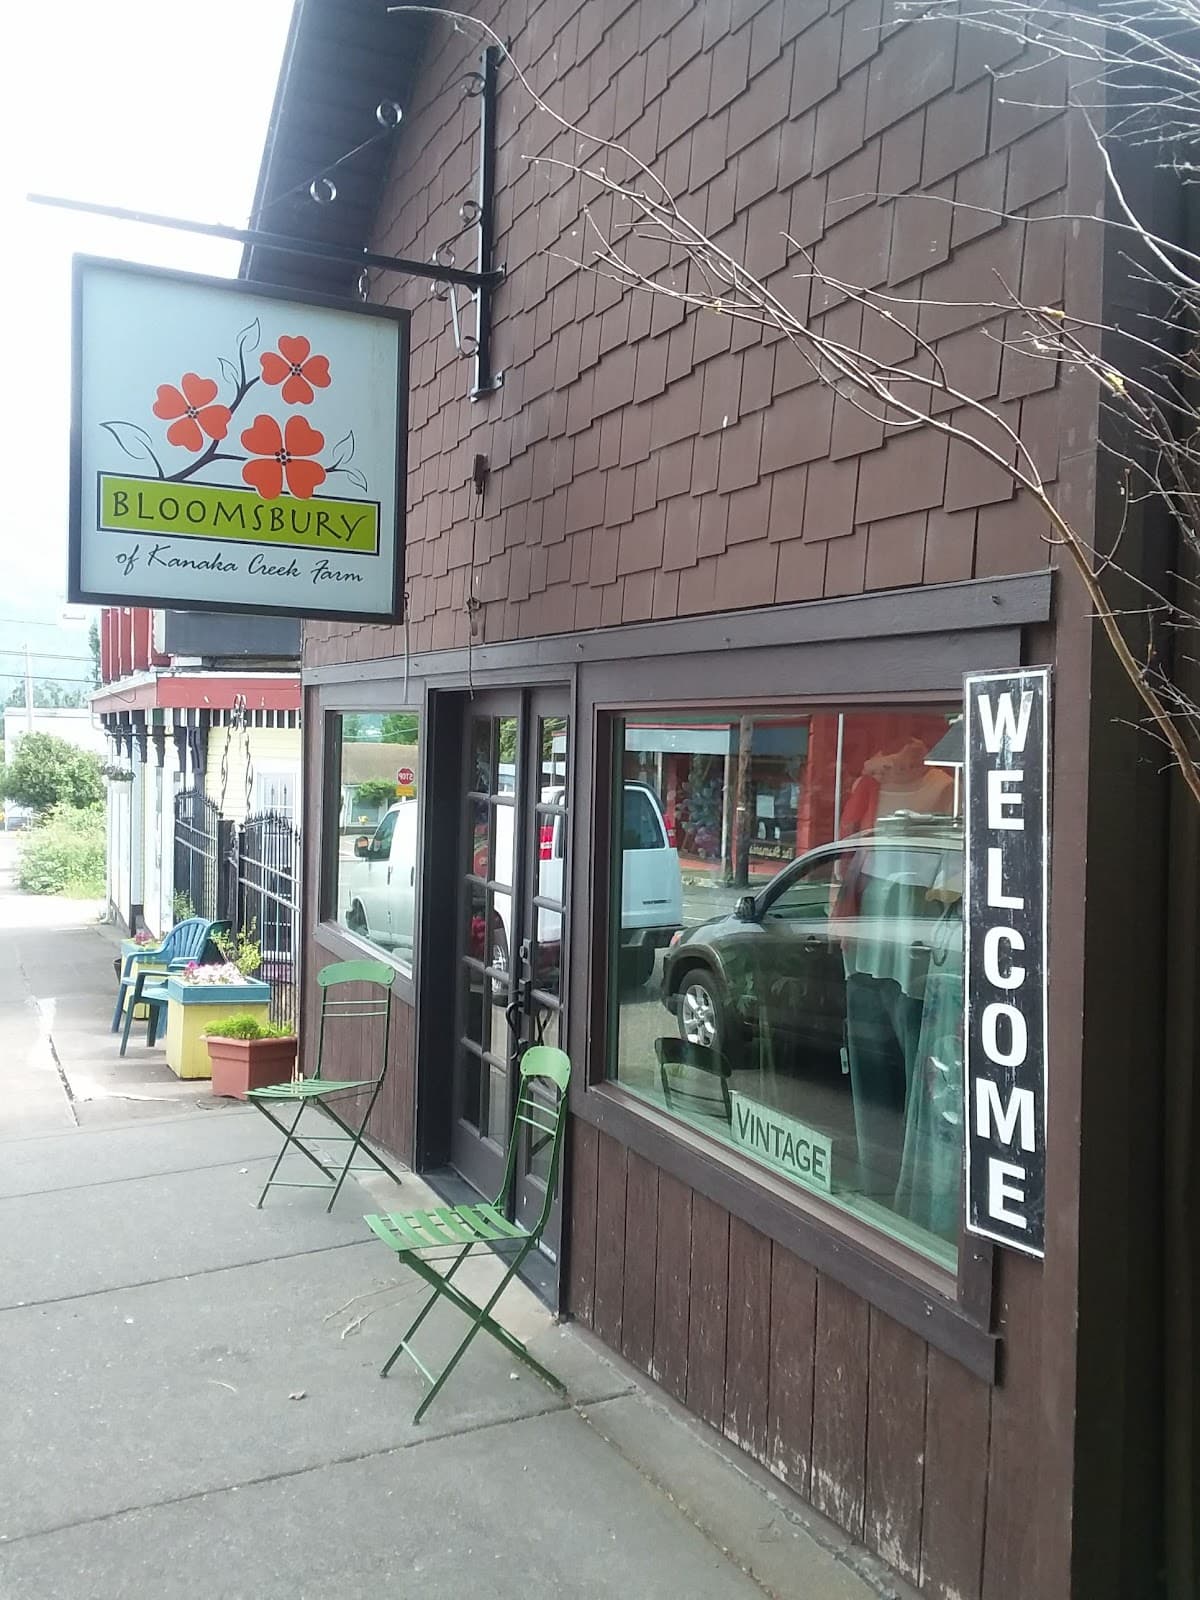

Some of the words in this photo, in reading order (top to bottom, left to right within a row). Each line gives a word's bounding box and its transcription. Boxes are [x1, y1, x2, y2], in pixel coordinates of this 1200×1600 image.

[113, 491, 367, 541] BLOOMSBURY
[117, 544, 139, 576] of
[148, 544, 238, 573] Kanaka
[248, 553, 302, 577] Creek
[311, 559, 363, 584] Farm
[976, 692, 1035, 1229] WELCOME
[737, 1102, 826, 1182] VINTAGE
